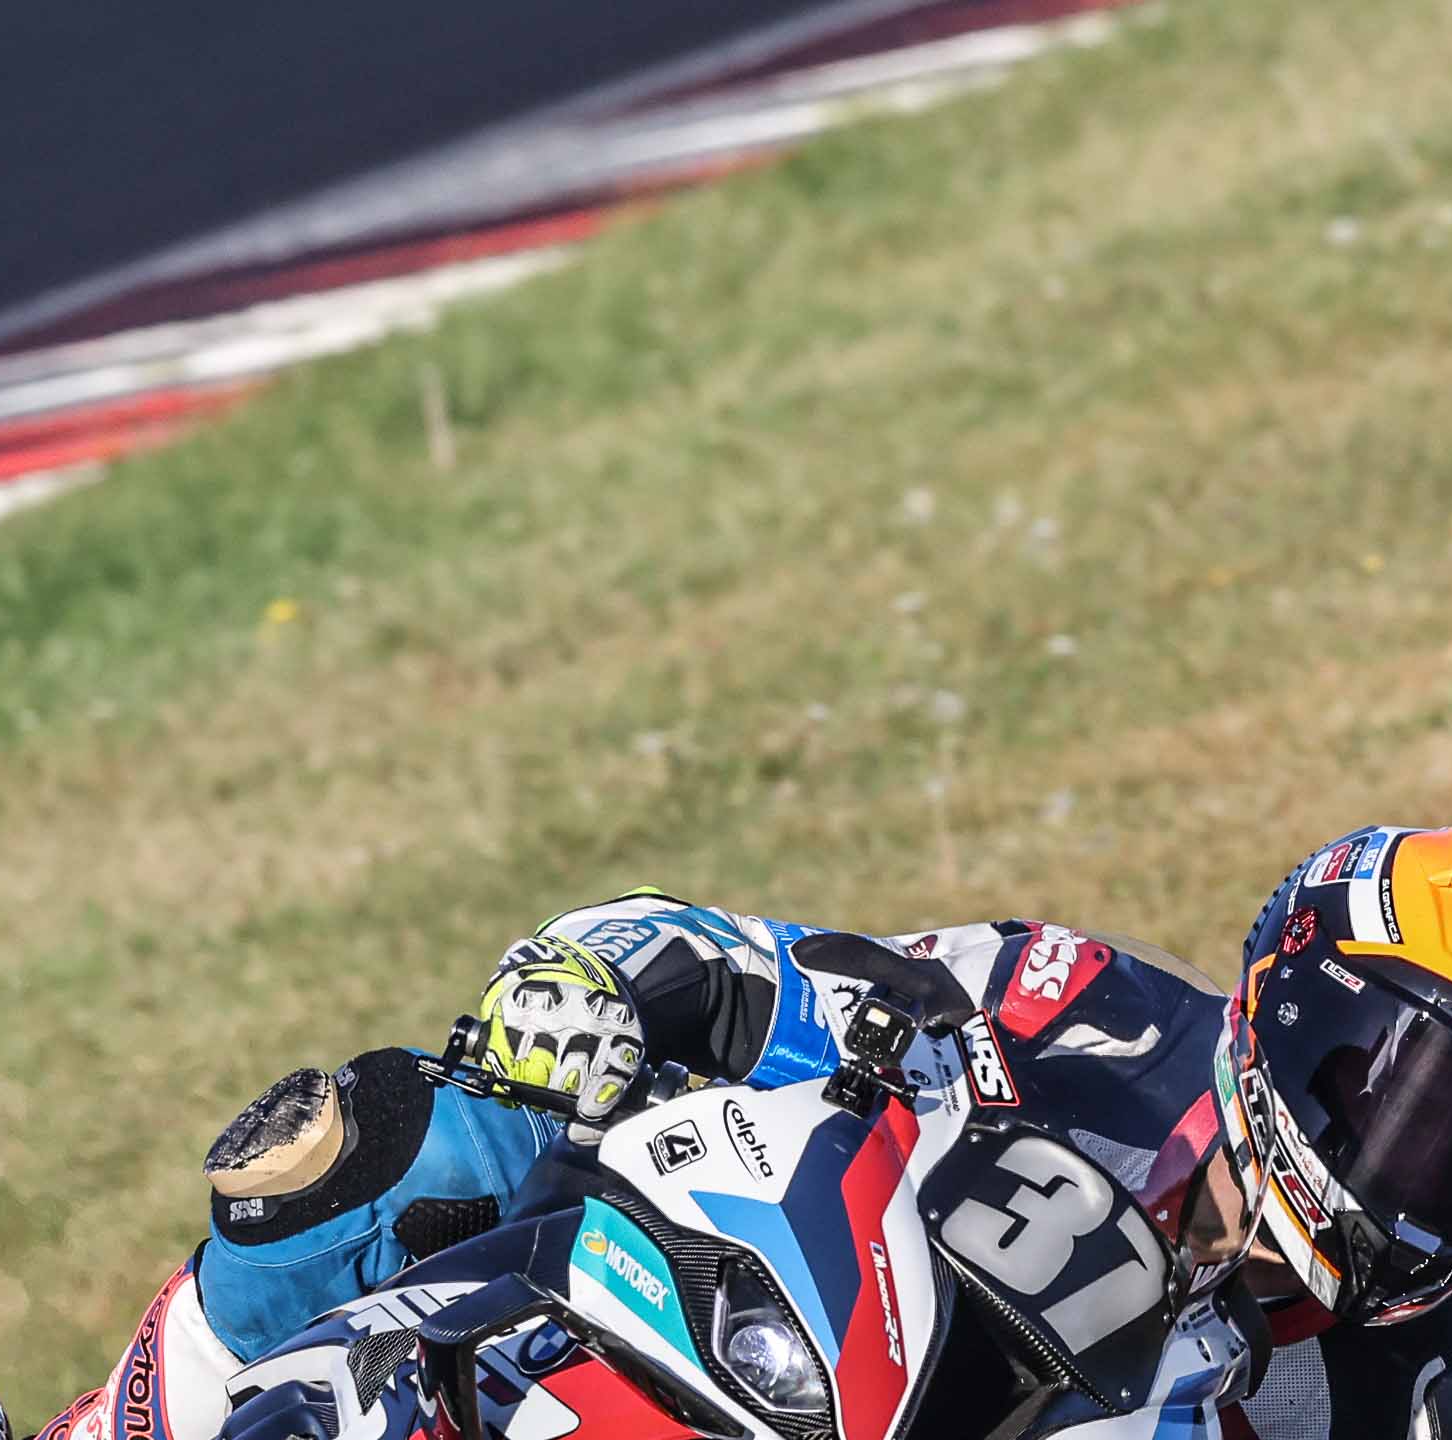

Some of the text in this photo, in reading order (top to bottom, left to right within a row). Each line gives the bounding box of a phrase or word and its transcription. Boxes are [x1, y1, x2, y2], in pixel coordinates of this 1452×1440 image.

[1320, 959, 1366, 994] LS2
[731, 1108, 773, 1178] alpha
[605, 1240, 670, 1311] MOTOREX
